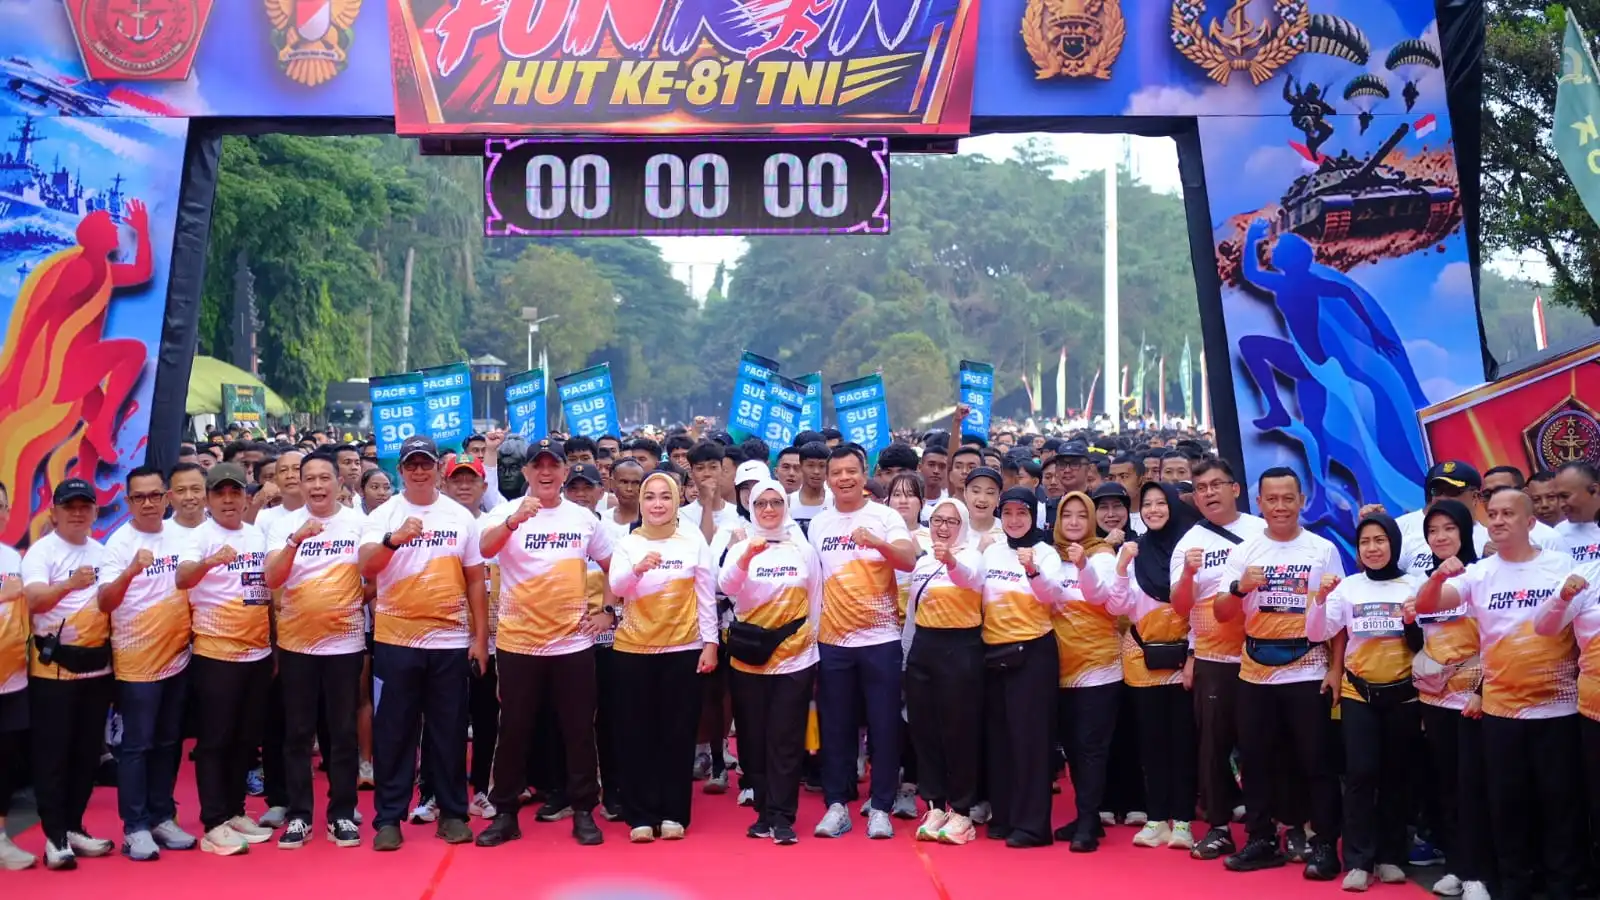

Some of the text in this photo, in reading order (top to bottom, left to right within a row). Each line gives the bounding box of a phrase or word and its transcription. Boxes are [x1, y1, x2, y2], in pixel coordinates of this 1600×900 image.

[493, 60, 842, 105] HUT KE-81 TNI
[525, 153, 848, 219] 00 00 00
[374, 388, 406, 399] PACE
[563, 381, 595, 397] PACE
[839, 387, 877, 404] PACE 7
[428, 395, 460, 409] SUB
[516, 400, 536, 417] SUB
[572, 398, 605, 415] SUB
[380, 406, 414, 420] SUB
[738, 400, 763, 421] 35
[770, 406, 794, 423] SUB
[847, 407, 878, 423] SUB
[431, 412, 460, 430] 45
[520, 417, 535, 437] 45
[578, 414, 607, 437] 35
[381, 423, 415, 442] 30
[766, 422, 791, 444] 30
[850, 423, 878, 444] 35
[434, 530, 457, 539] RUN
[526, 532, 581, 542] FUN RUN
[823, 536, 840, 545] FUN
[301, 549, 321, 557] HUT
[324, 547, 341, 556] TNI
[302, 540, 354, 550] FUN RUN
[525, 541, 548, 549] HUT
[550, 541, 567, 549] TNI
[821, 544, 839, 552] HUT
[841, 543, 856, 551] TNI
[1205, 548, 1230, 561] FUN
[227, 561, 260, 572] HUT TNI
[1204, 557, 1227, 569] HUT
[1287, 565, 1312, 573] RUN
[1412, 560, 1432, 569] HUT
[146, 565, 165, 577] HUT
[1267, 597, 1300, 605] 810099
[1490, 588, 1555, 602] FUN RUN
[1488, 599, 1537, 610] HUT TNI
[1362, 620, 1395, 629] 810100
